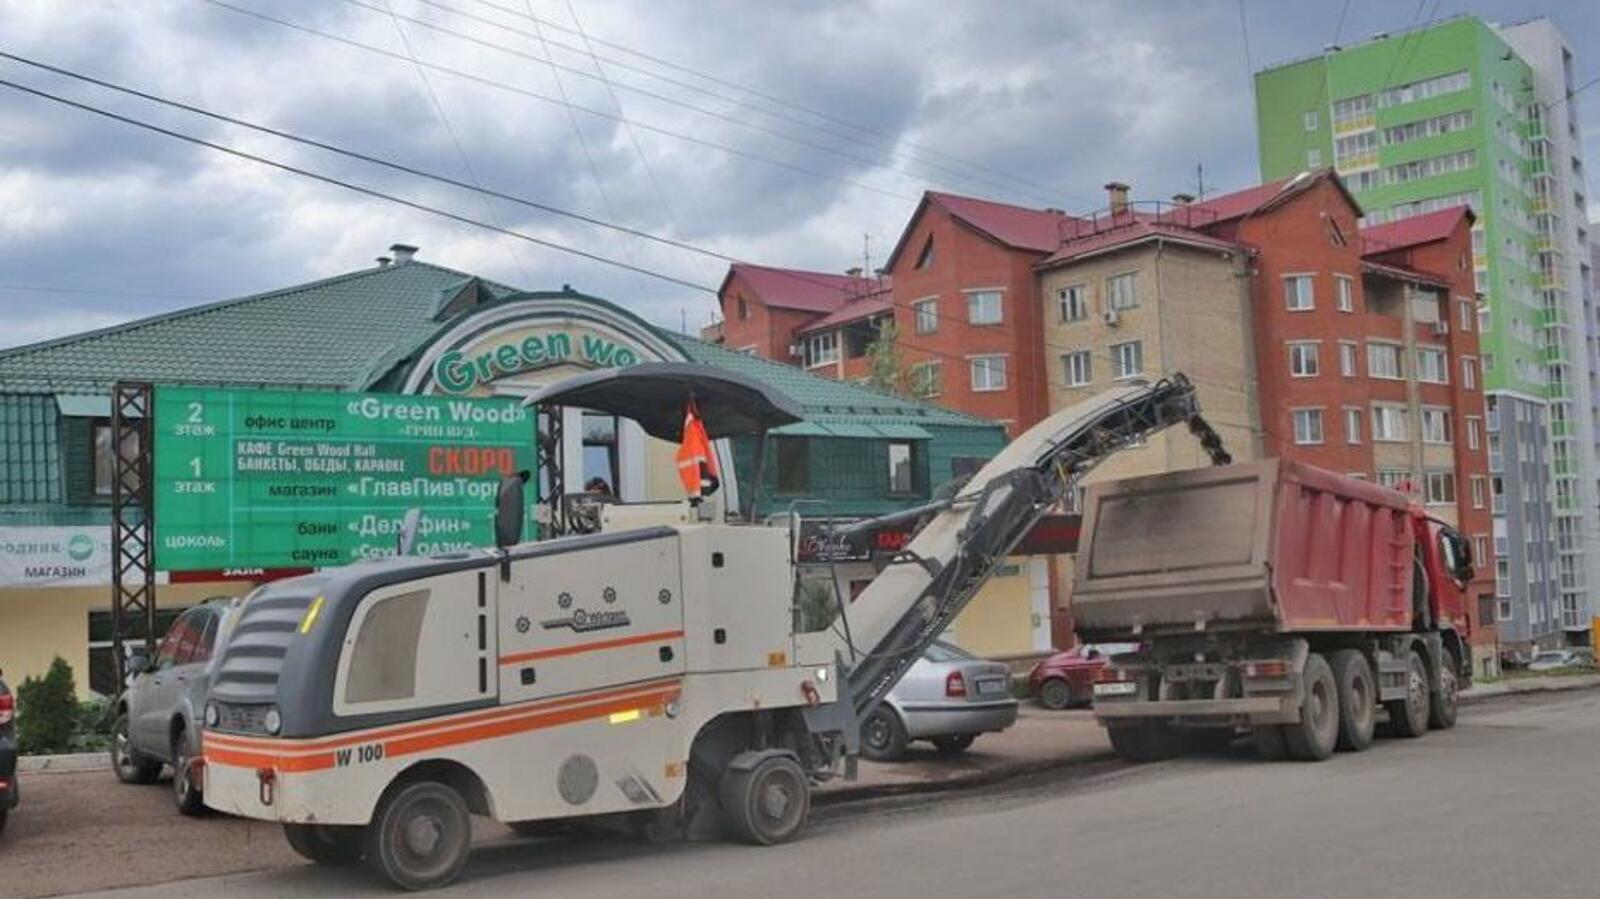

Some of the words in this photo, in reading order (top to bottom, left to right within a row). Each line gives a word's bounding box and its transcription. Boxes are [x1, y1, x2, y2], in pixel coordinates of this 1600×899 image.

[434, 331, 571, 392] Green
[582, 333, 640, 368] wo
[188, 403, 203, 423] 2
[347, 397, 440, 420] «Green
[449, 401, 526, 423] Wood»
[175, 425, 216, 436] этаж
[245, 415, 286, 429] офис
[290, 416, 336, 431] центр
[237, 441, 272, 456] КАФЕ
[278, 442, 313, 456] Green
[317, 442, 350, 457] Wood
[354, 443, 376, 457] Hall
[189, 457, 201, 477] 1
[355, 459, 405, 473] КАРАОКЕ
[429, 446, 515, 474] СКОРО
[175, 482, 215, 493] этаж
[269, 485, 337, 497] магазин
[298, 523, 336, 535] бани
[347, 515, 471, 537] «Делфин»
[0, 542, 61, 555] ОДНИК
[292, 549, 339, 562] сауна
[25, 566, 86, 578] МАГАЗИН
[336, 749, 352, 766] W
[357, 745, 382, 762] 100
